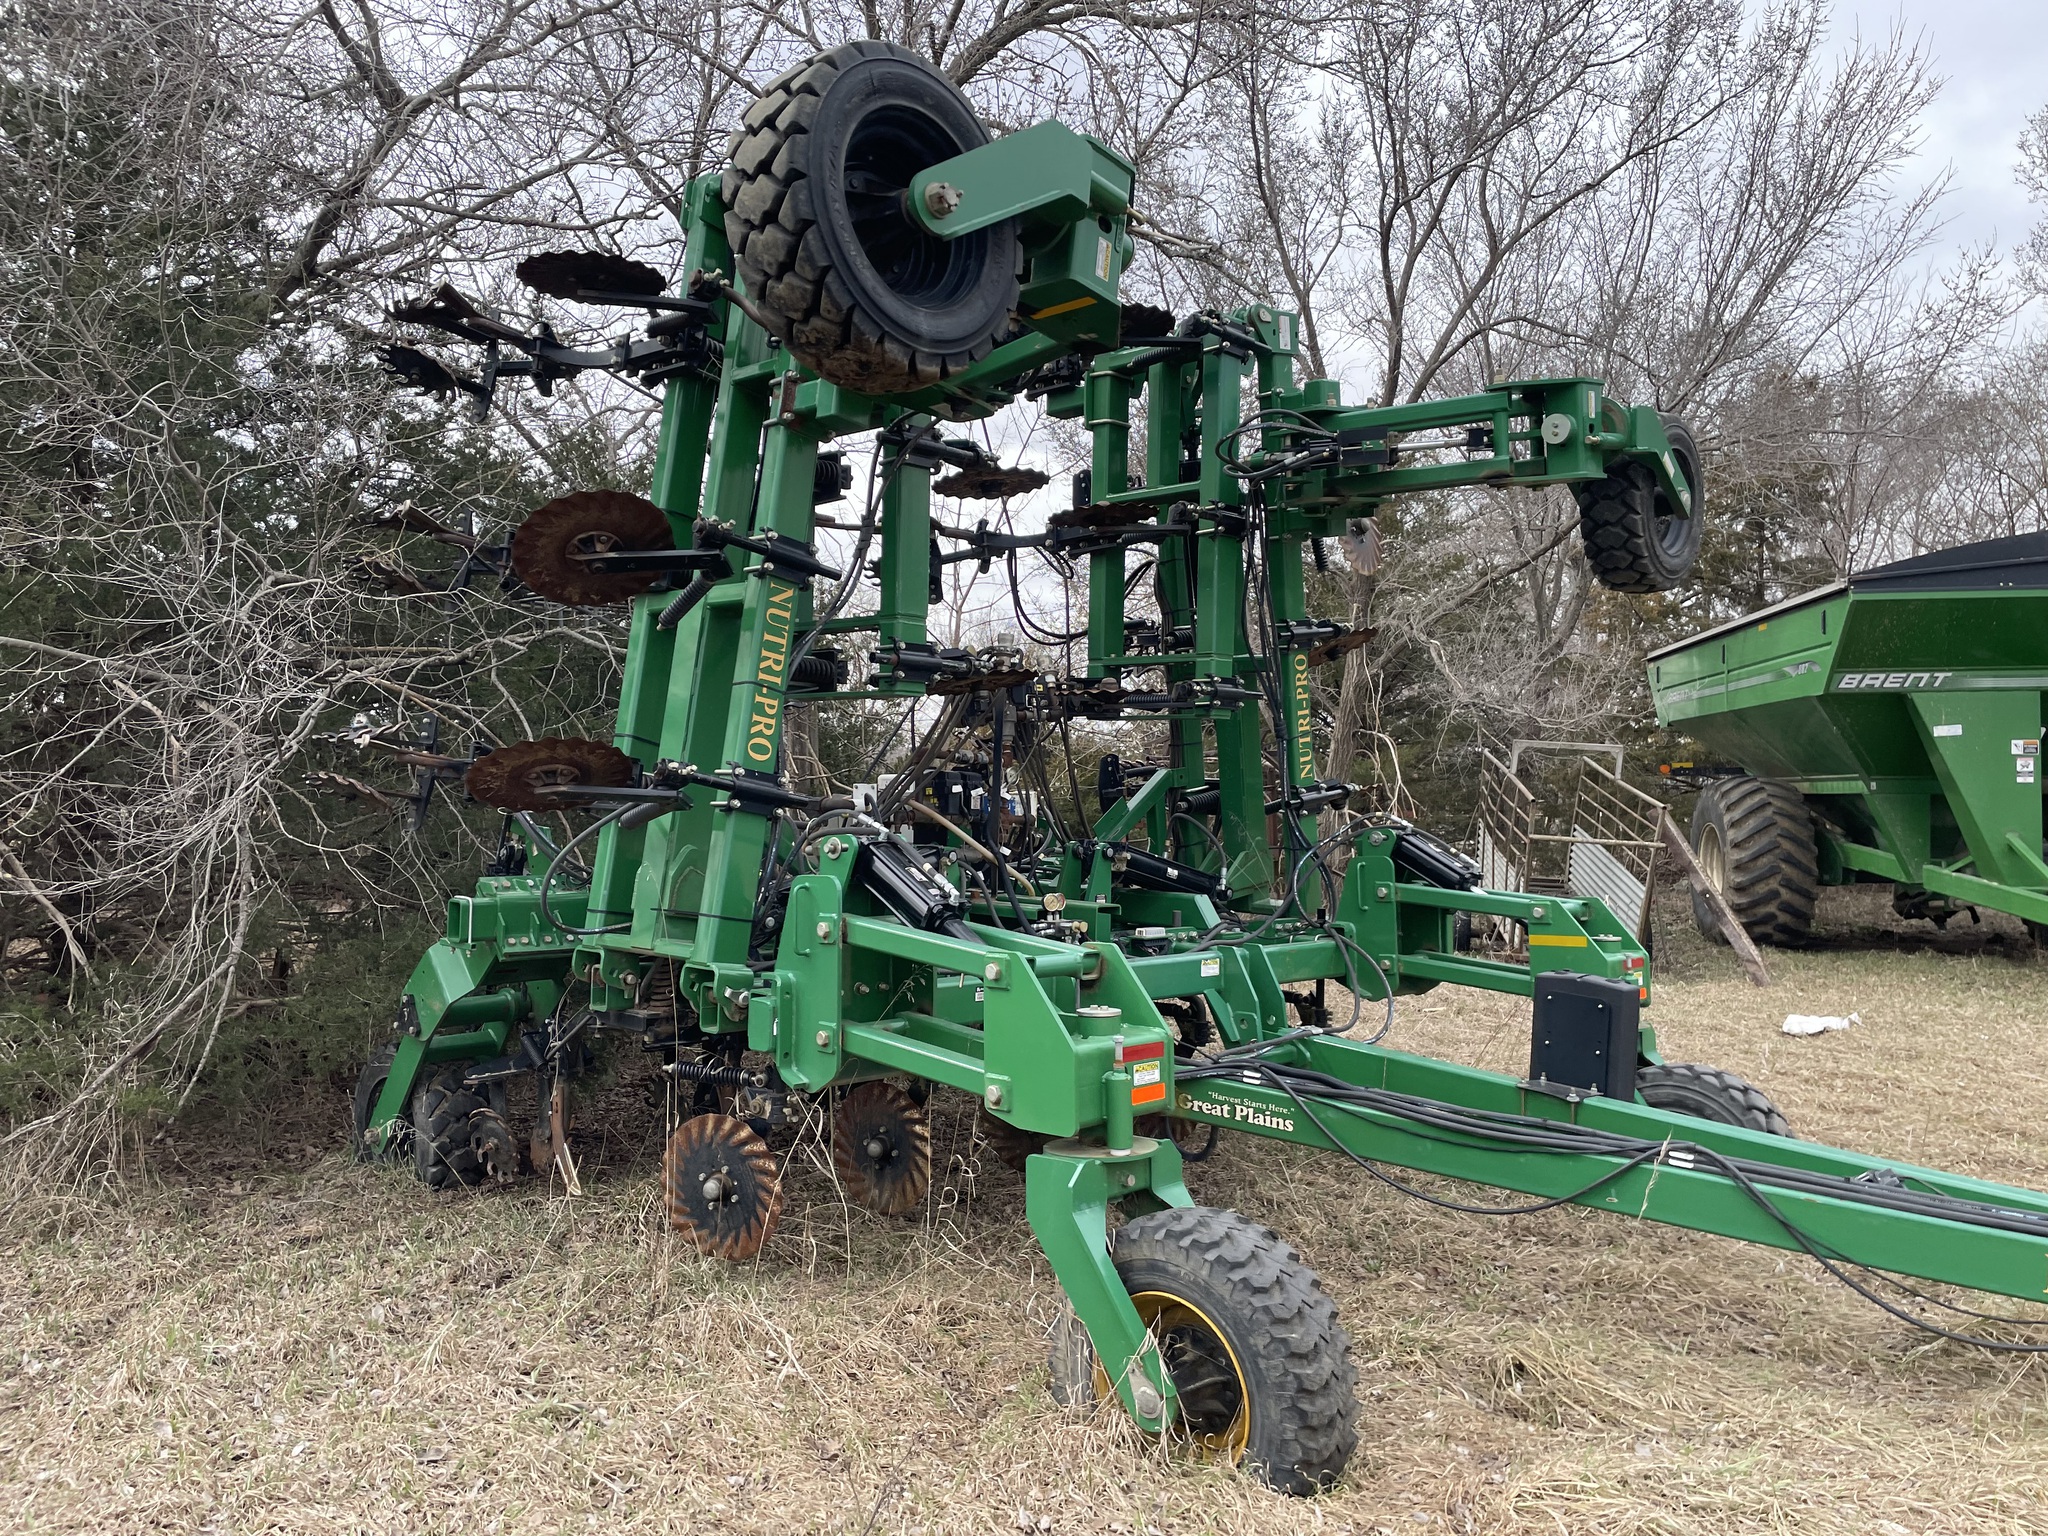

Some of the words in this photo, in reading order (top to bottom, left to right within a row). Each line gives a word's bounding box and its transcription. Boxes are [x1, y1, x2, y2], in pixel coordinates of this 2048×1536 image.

[747, 581, 794, 762] NUTRI-PRO
[1838, 672, 1952, 688] BRENT
[1294, 653, 1313, 780] NUTRI-PRO
[1178, 1093, 1230, 1118] Great
[1234, 1104, 1294, 1132] Plains
[1243, 1098, 1266, 1110] Starts
